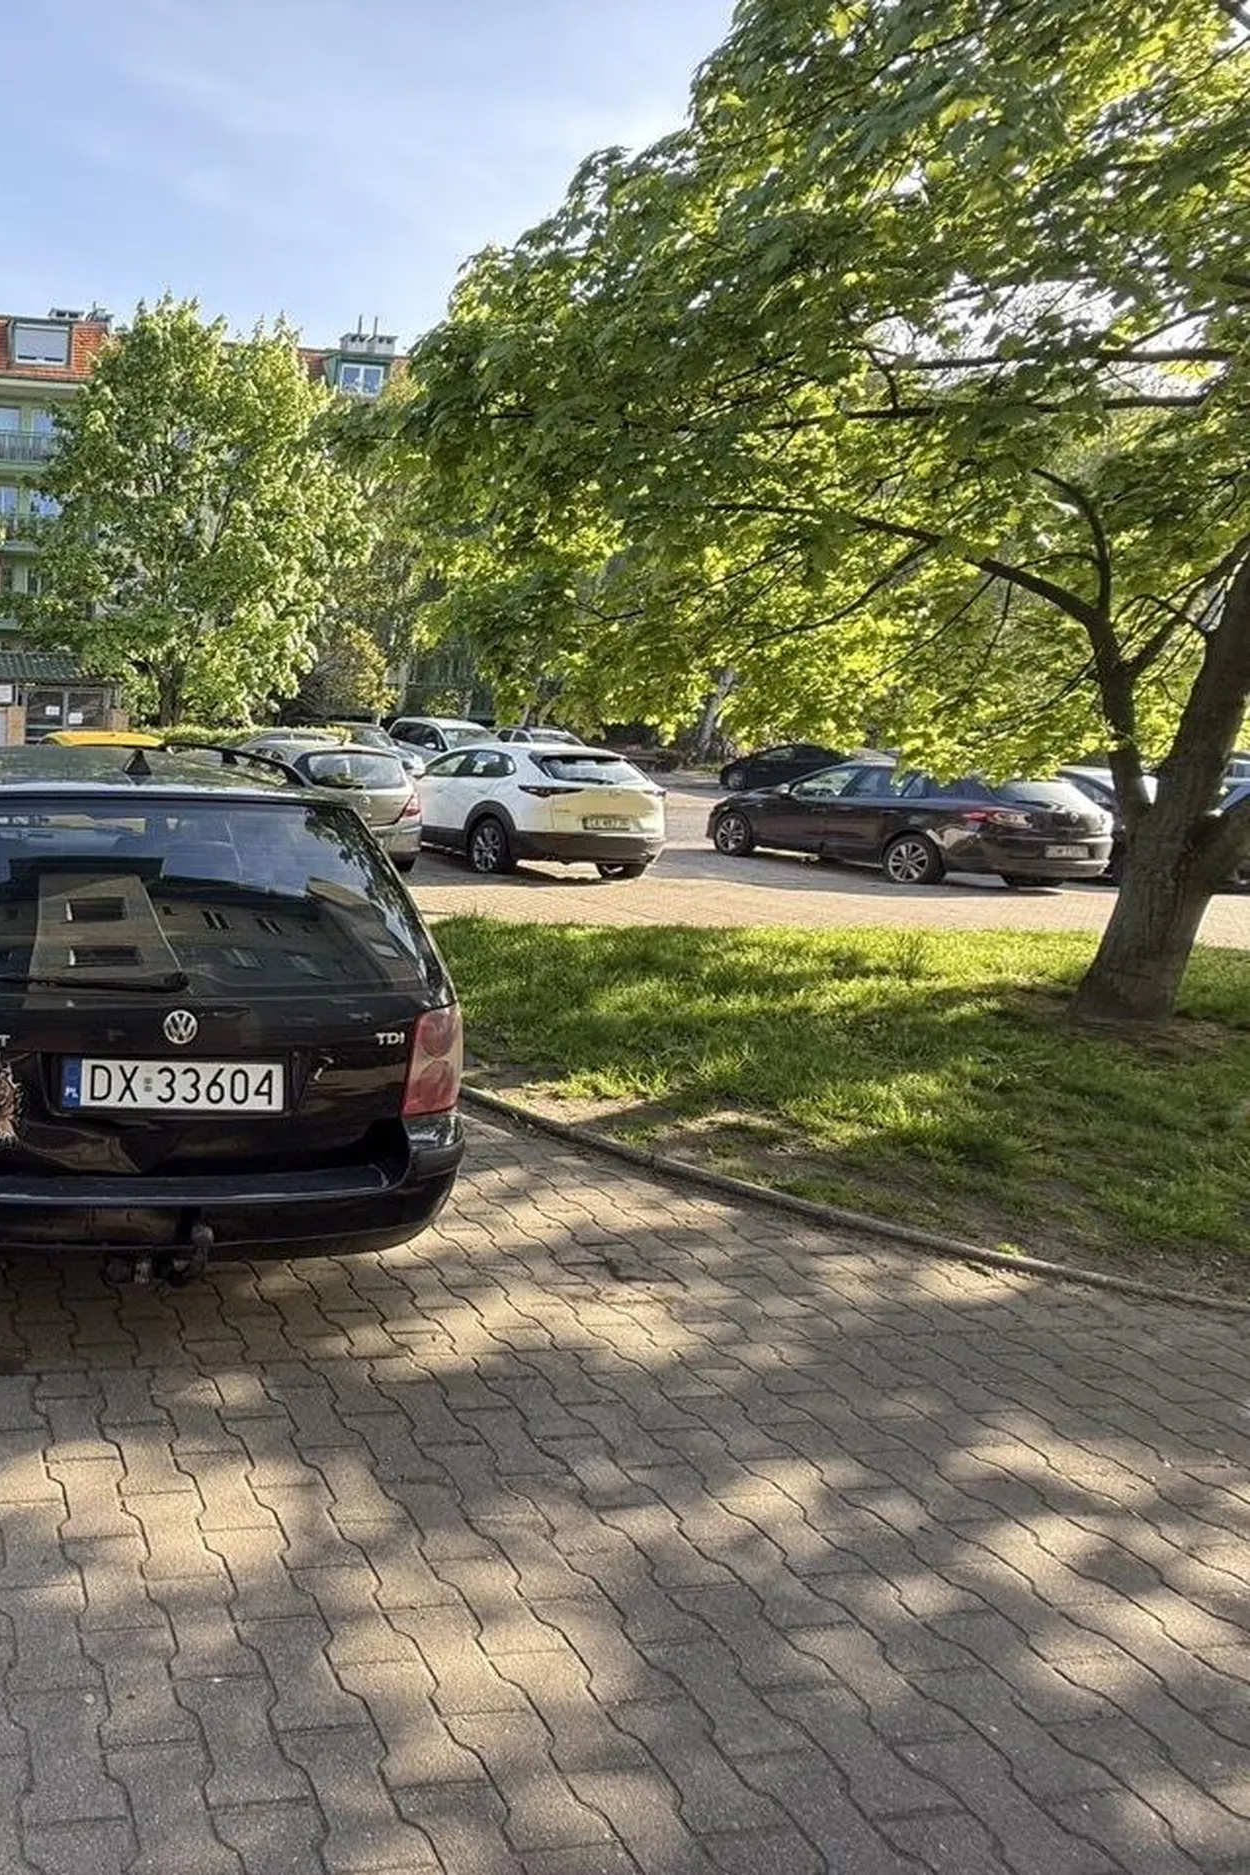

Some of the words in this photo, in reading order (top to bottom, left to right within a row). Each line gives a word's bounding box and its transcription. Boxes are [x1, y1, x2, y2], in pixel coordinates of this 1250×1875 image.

[375, 1031, 405, 1046] TDI
[90, 1064, 139, 1103] DX
[157, 1066, 273, 1105] 33604
[64, 1087, 79, 1098] PL
